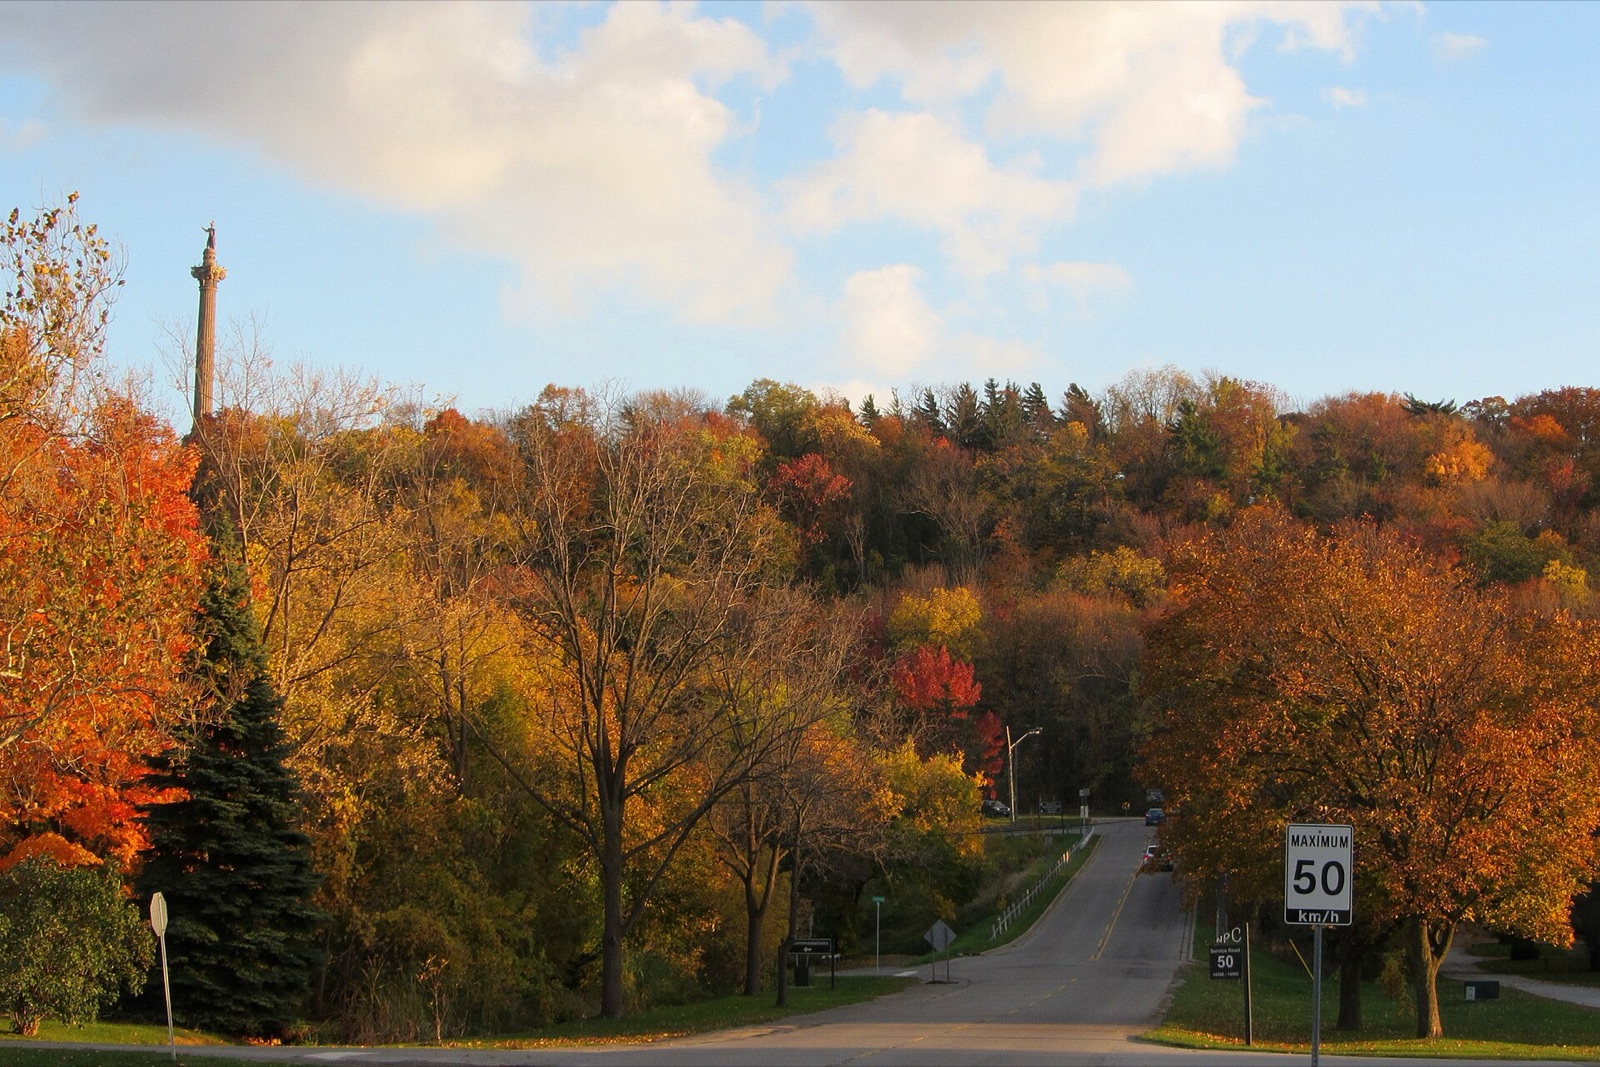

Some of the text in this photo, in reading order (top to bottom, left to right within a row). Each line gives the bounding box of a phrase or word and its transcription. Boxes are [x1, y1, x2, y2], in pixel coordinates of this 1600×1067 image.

[1291, 834, 1349, 848] MAXIMUM
[1293, 859, 1345, 896] 50
[1298, 909, 1339, 923] km/h
[1217, 954, 1234, 969] 50
